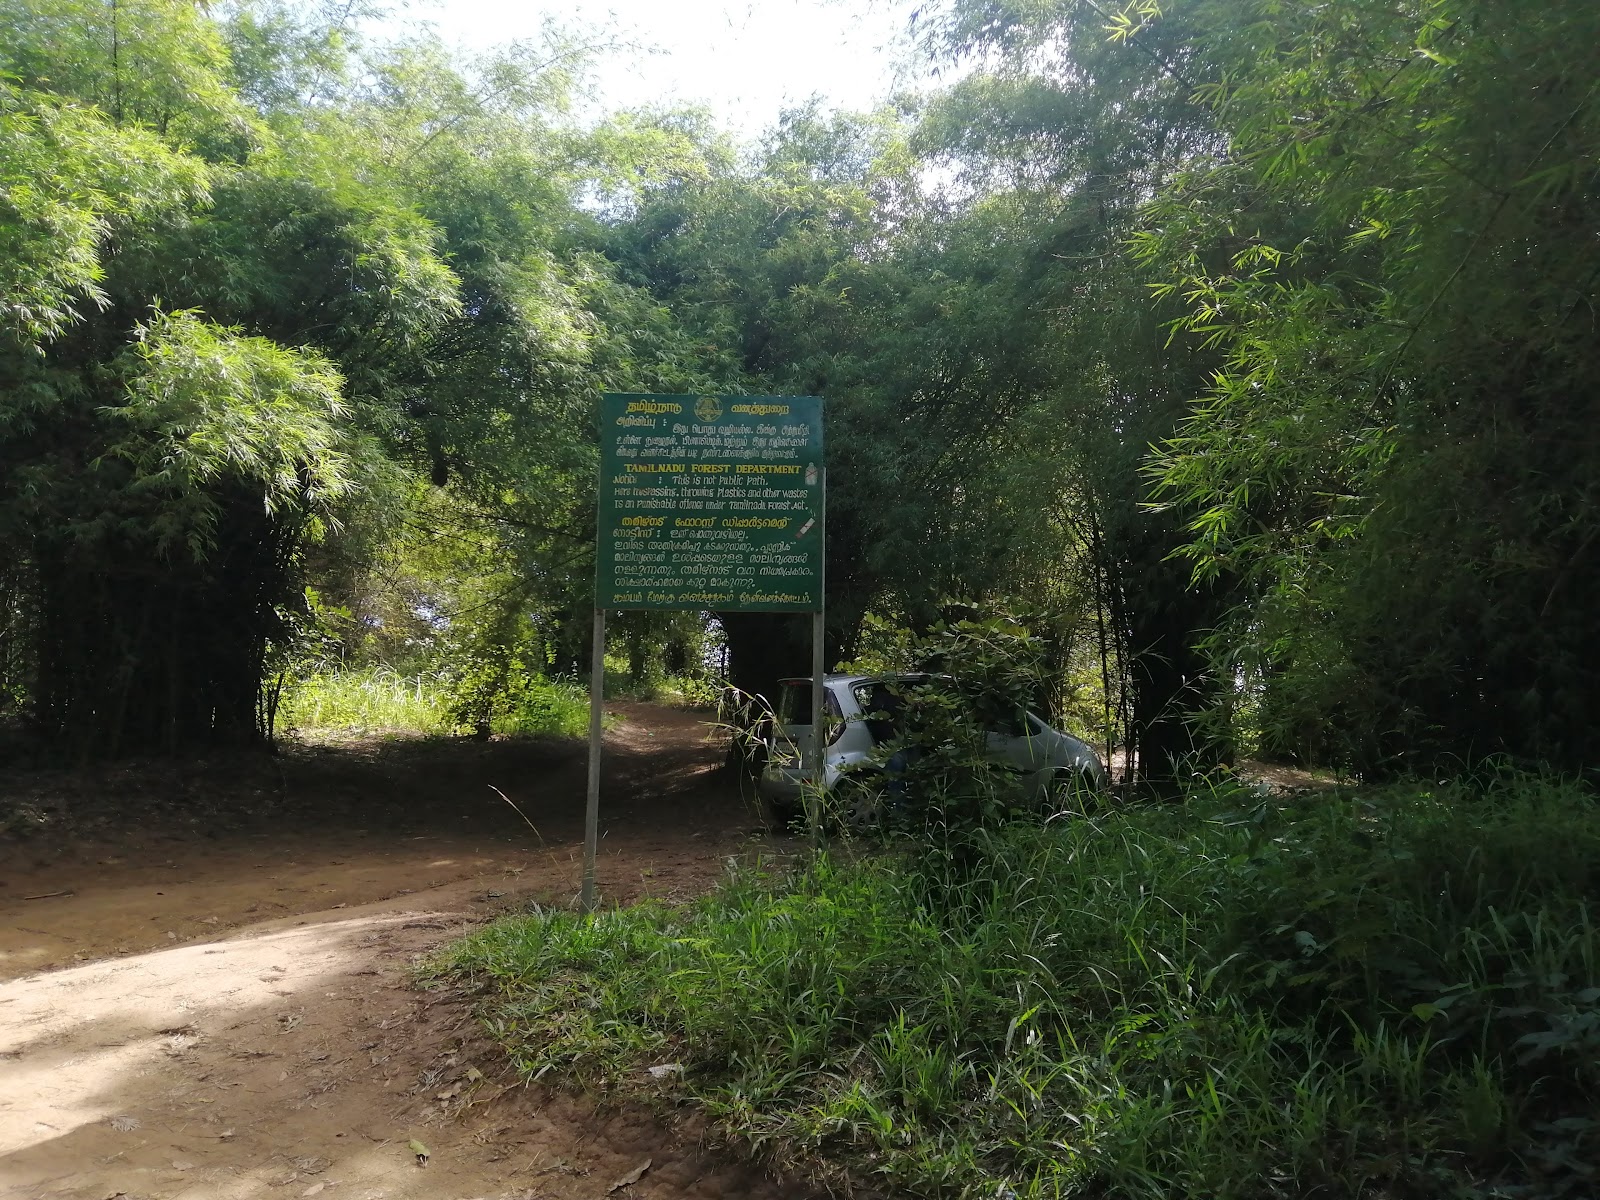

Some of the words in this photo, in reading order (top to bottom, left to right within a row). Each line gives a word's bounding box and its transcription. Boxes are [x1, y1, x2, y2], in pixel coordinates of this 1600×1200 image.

[626, 398, 682, 414] தமிழ்நாடு
[731, 402, 790, 416] வனத்துறை
[616, 415, 656, 429] அறிவிப்பு
[672, 423, 689, 436] இது
[690, 464, 732, 474] FOREST
[736, 464, 802, 474] DEPARTMENT
[672, 474, 690, 485] This
[692, 474, 702, 485] is
[704, 475, 717, 485] not
[614, 488, 631, 496] Here
[680, 486, 715, 498] throwing
[748, 488, 762, 498] and
[762, 488, 782, 498] other
[624, 500, 634, 508] an
[706, 500, 726, 510] under
